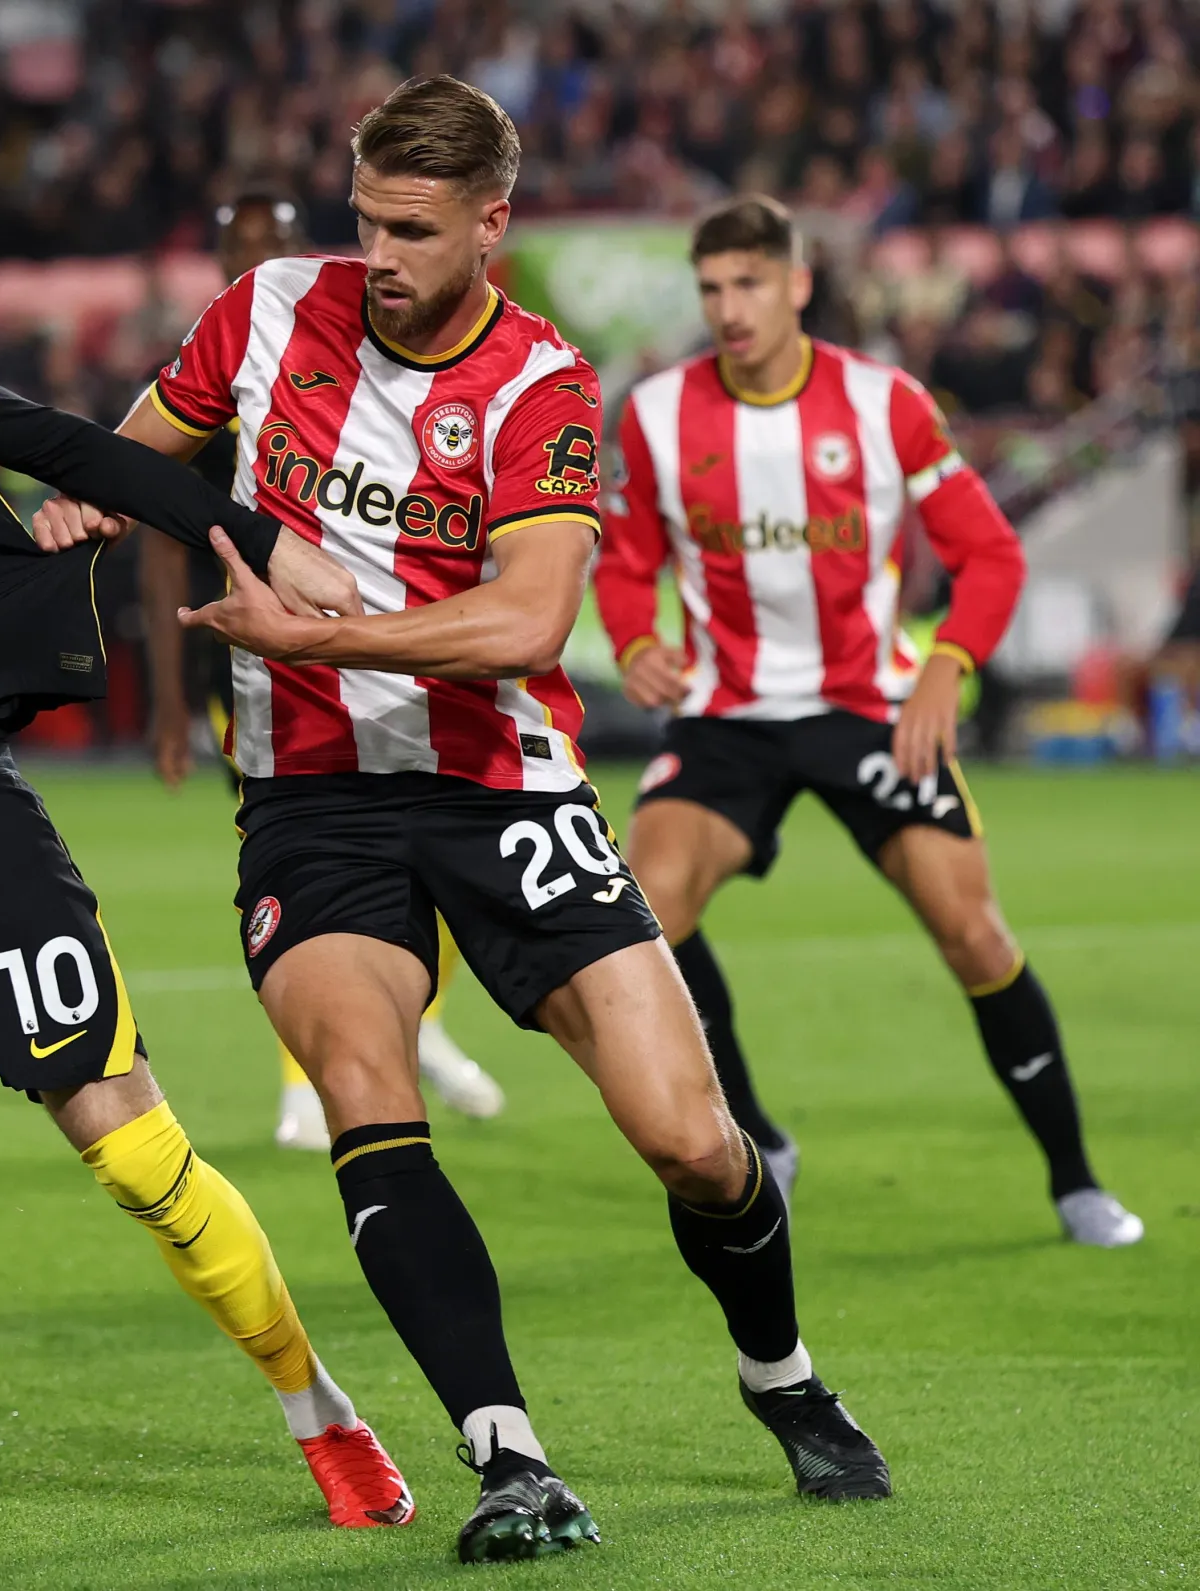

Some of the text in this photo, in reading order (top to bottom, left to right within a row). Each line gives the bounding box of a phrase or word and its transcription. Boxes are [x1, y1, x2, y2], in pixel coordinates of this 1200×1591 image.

[433, 406, 475, 426] BRENTFORD
[256, 421, 484, 551] indeed
[427, 446, 472, 465] FOOTBALL CLUB
[499, 803, 620, 908] 20
